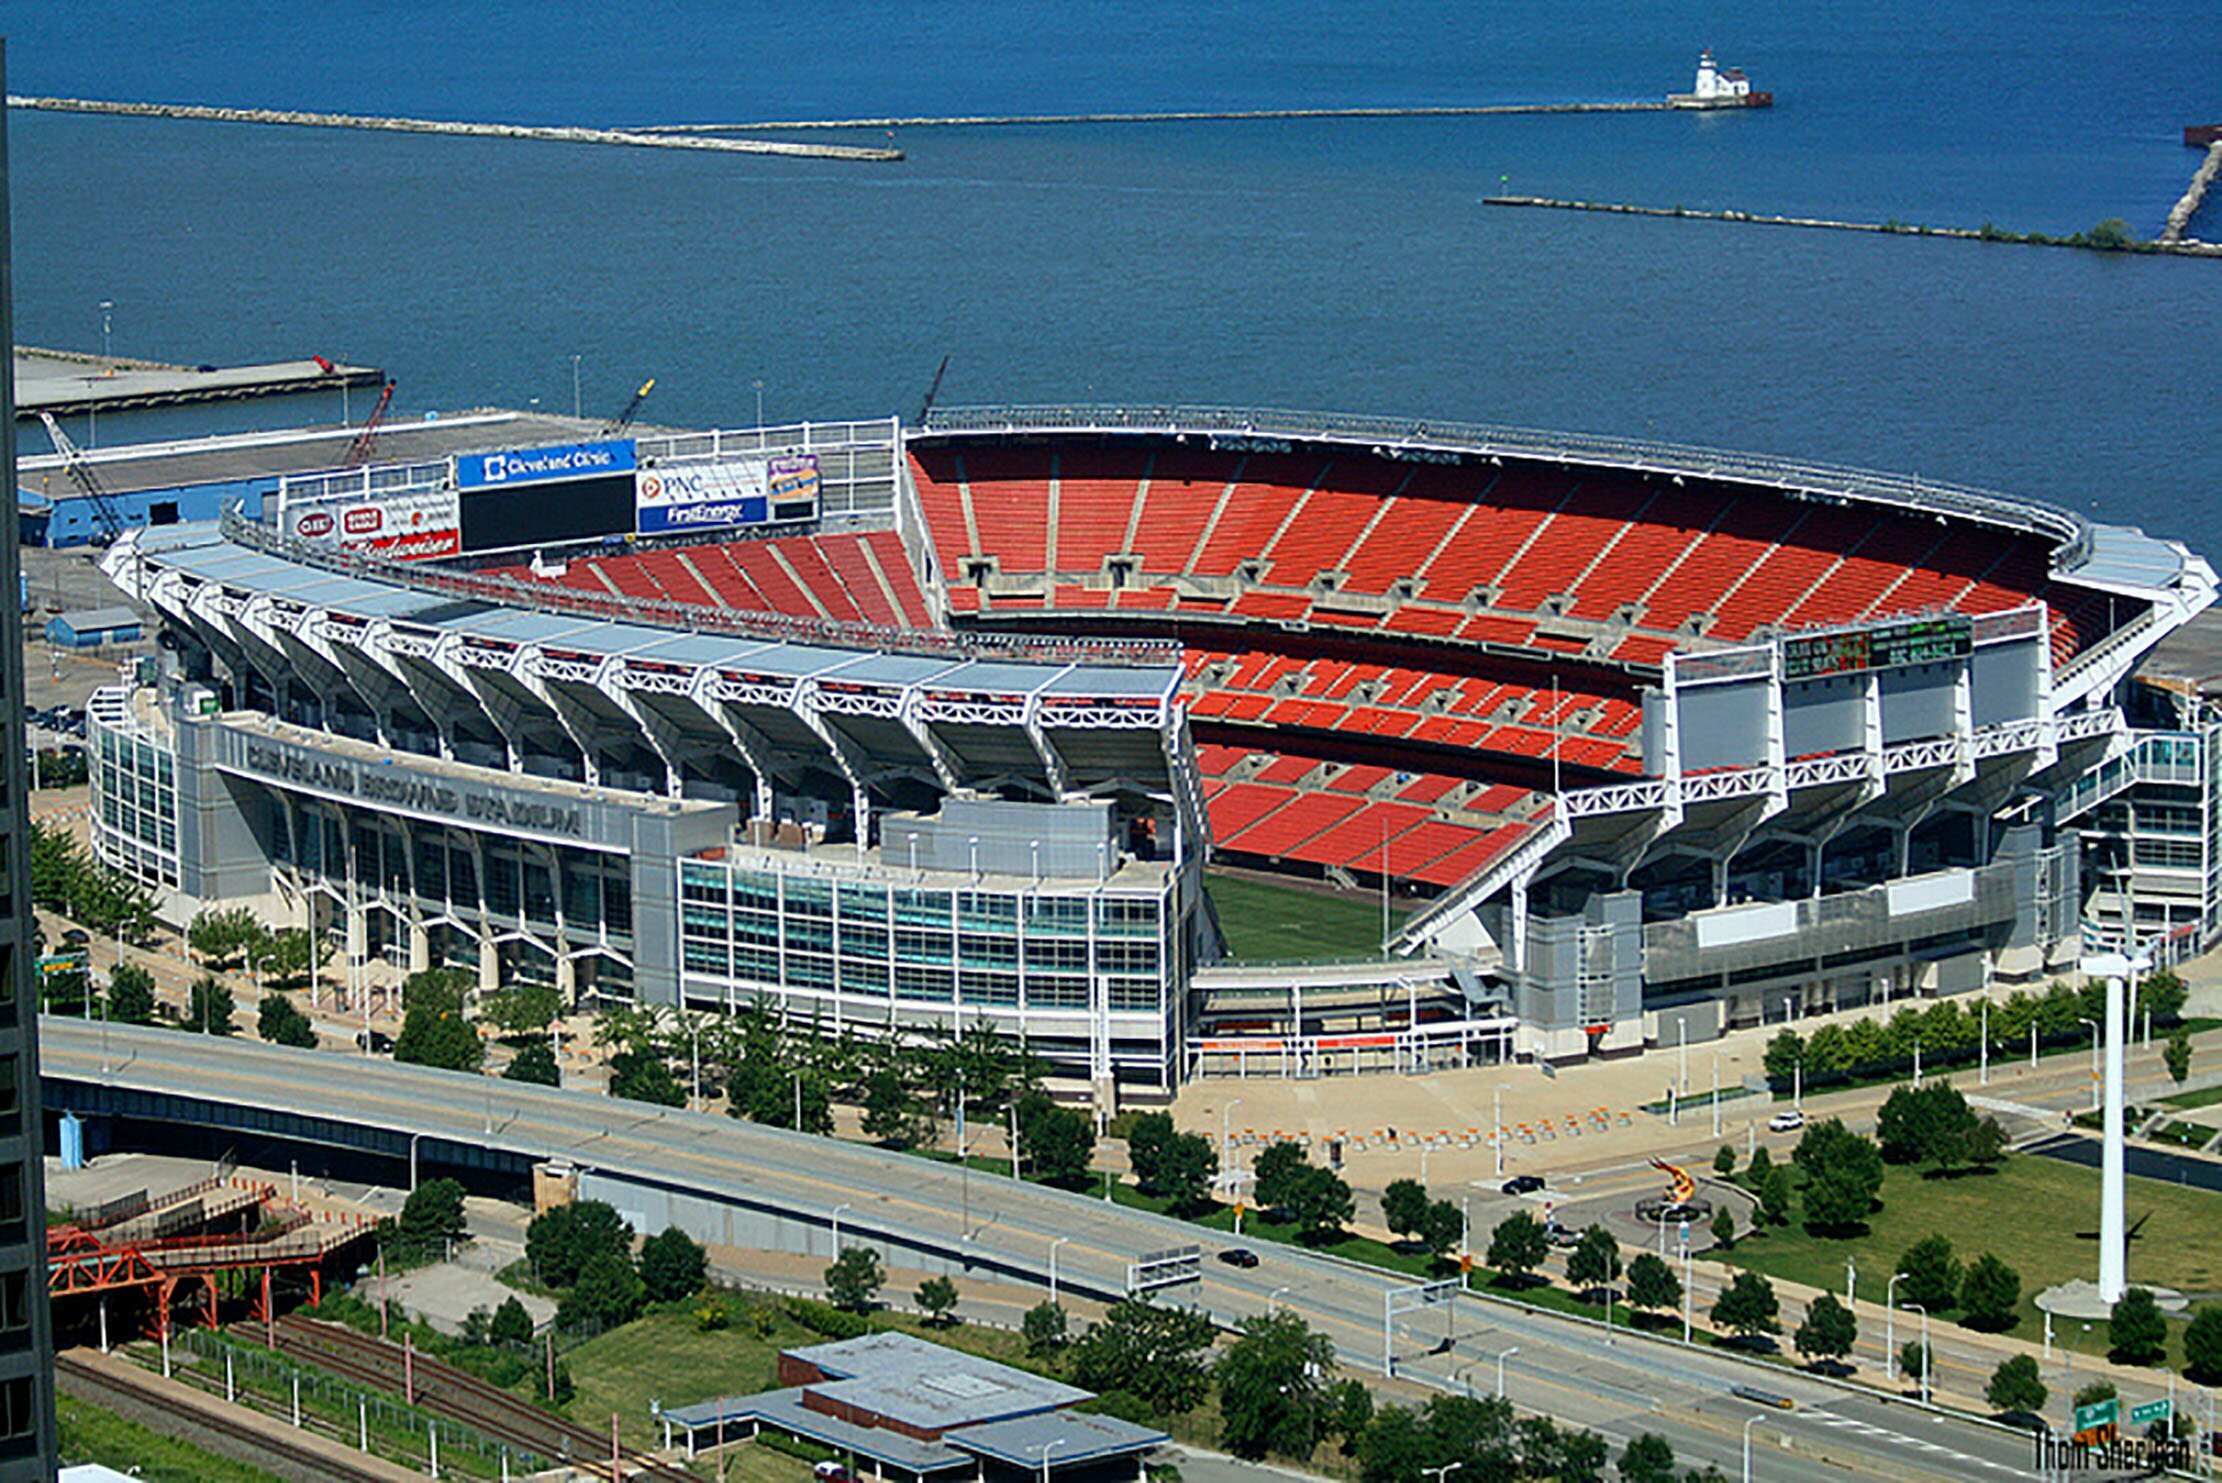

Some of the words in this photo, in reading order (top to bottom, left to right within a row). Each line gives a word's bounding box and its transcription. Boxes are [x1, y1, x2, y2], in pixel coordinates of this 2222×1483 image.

[507, 454, 571, 475] Cleveland
[573, 450, 610, 468] Clinic
[663, 474, 702, 494] PNC
[667, 503, 744, 524] FirstEnergy
[354, 535, 456, 559] Budweiser
[248, 746, 354, 794] CLEVELAND
[362, 771, 458, 813] BROWNS
[466, 793, 581, 836] STADIUM
